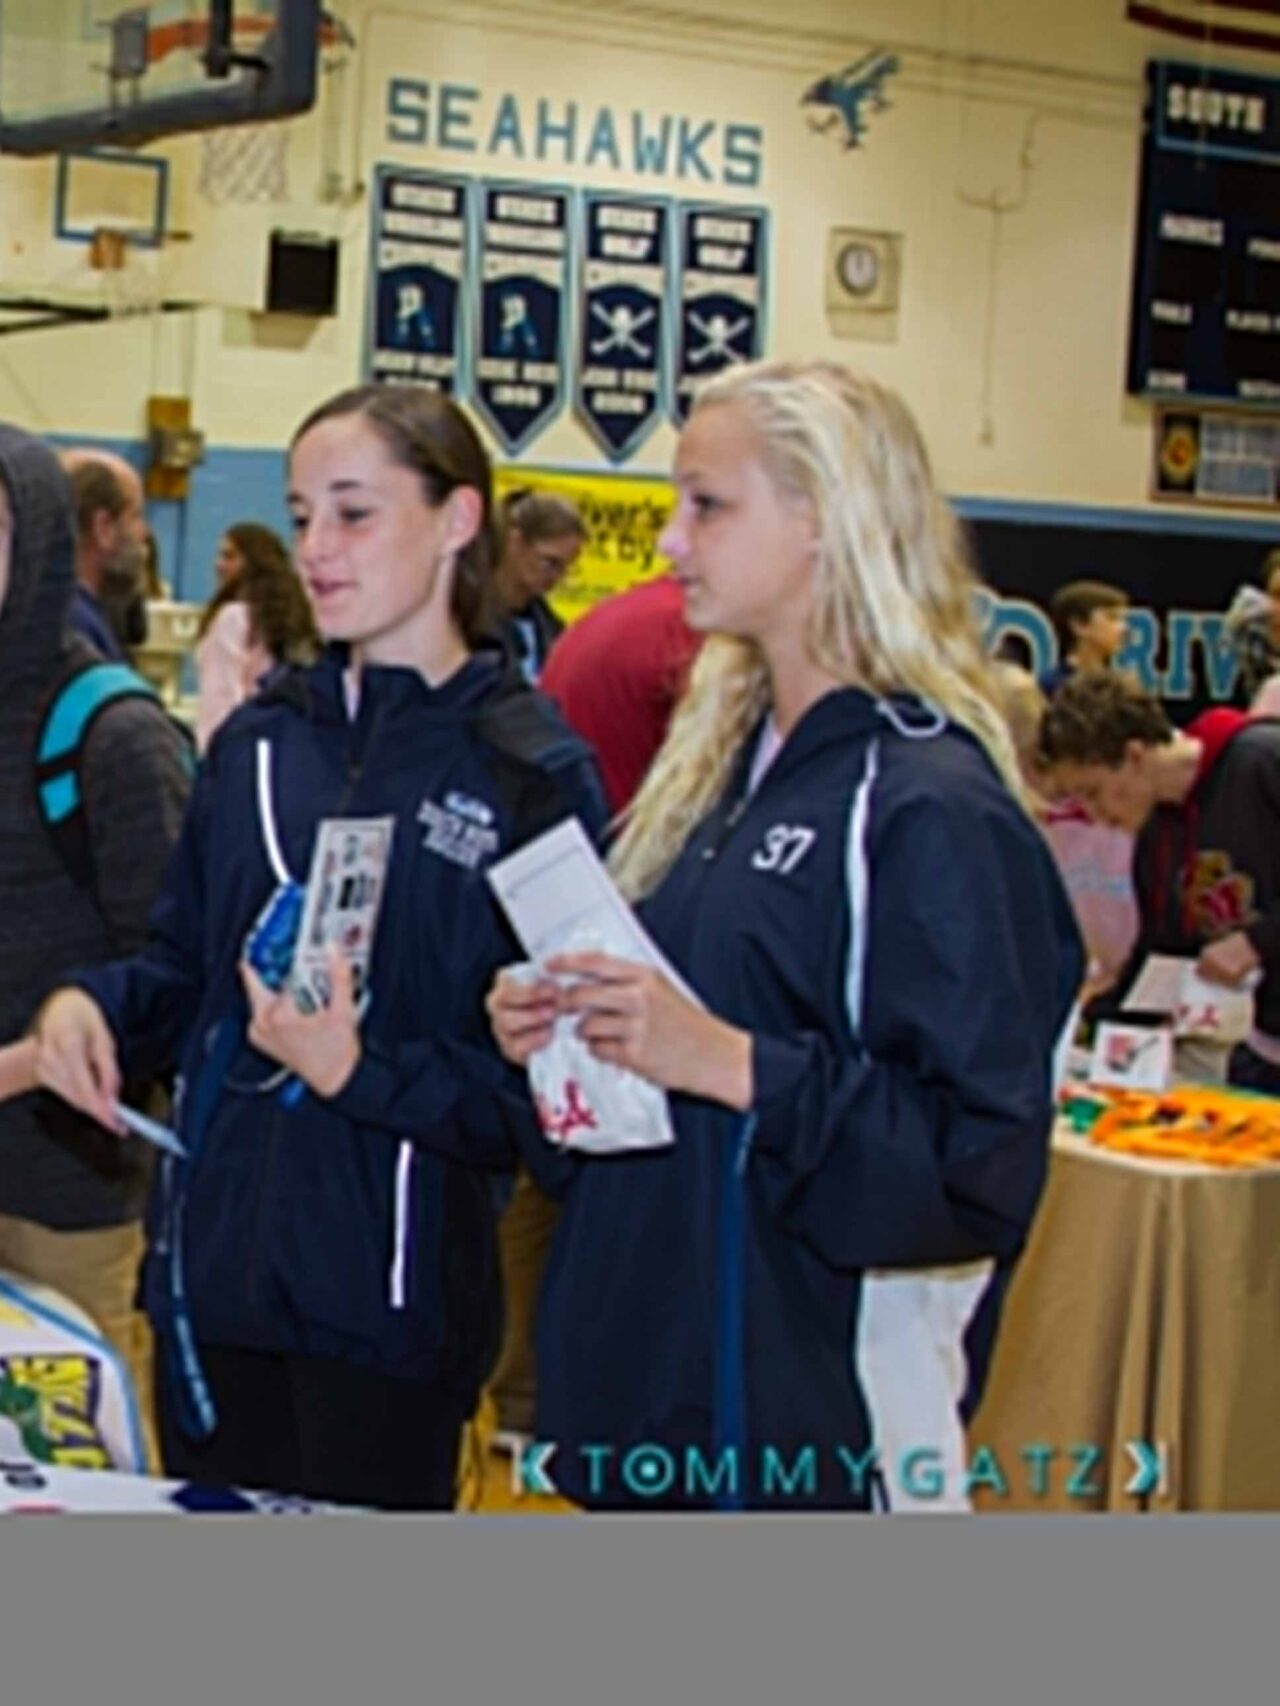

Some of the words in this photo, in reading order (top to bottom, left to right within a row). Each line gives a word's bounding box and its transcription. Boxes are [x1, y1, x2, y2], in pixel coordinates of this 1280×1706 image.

[387, 77, 763, 188] SEAHAWKS
[577, 492, 667, 532] iver's
[1112, 607, 1240, 699] RIV
[751, 822, 816, 875] 37
